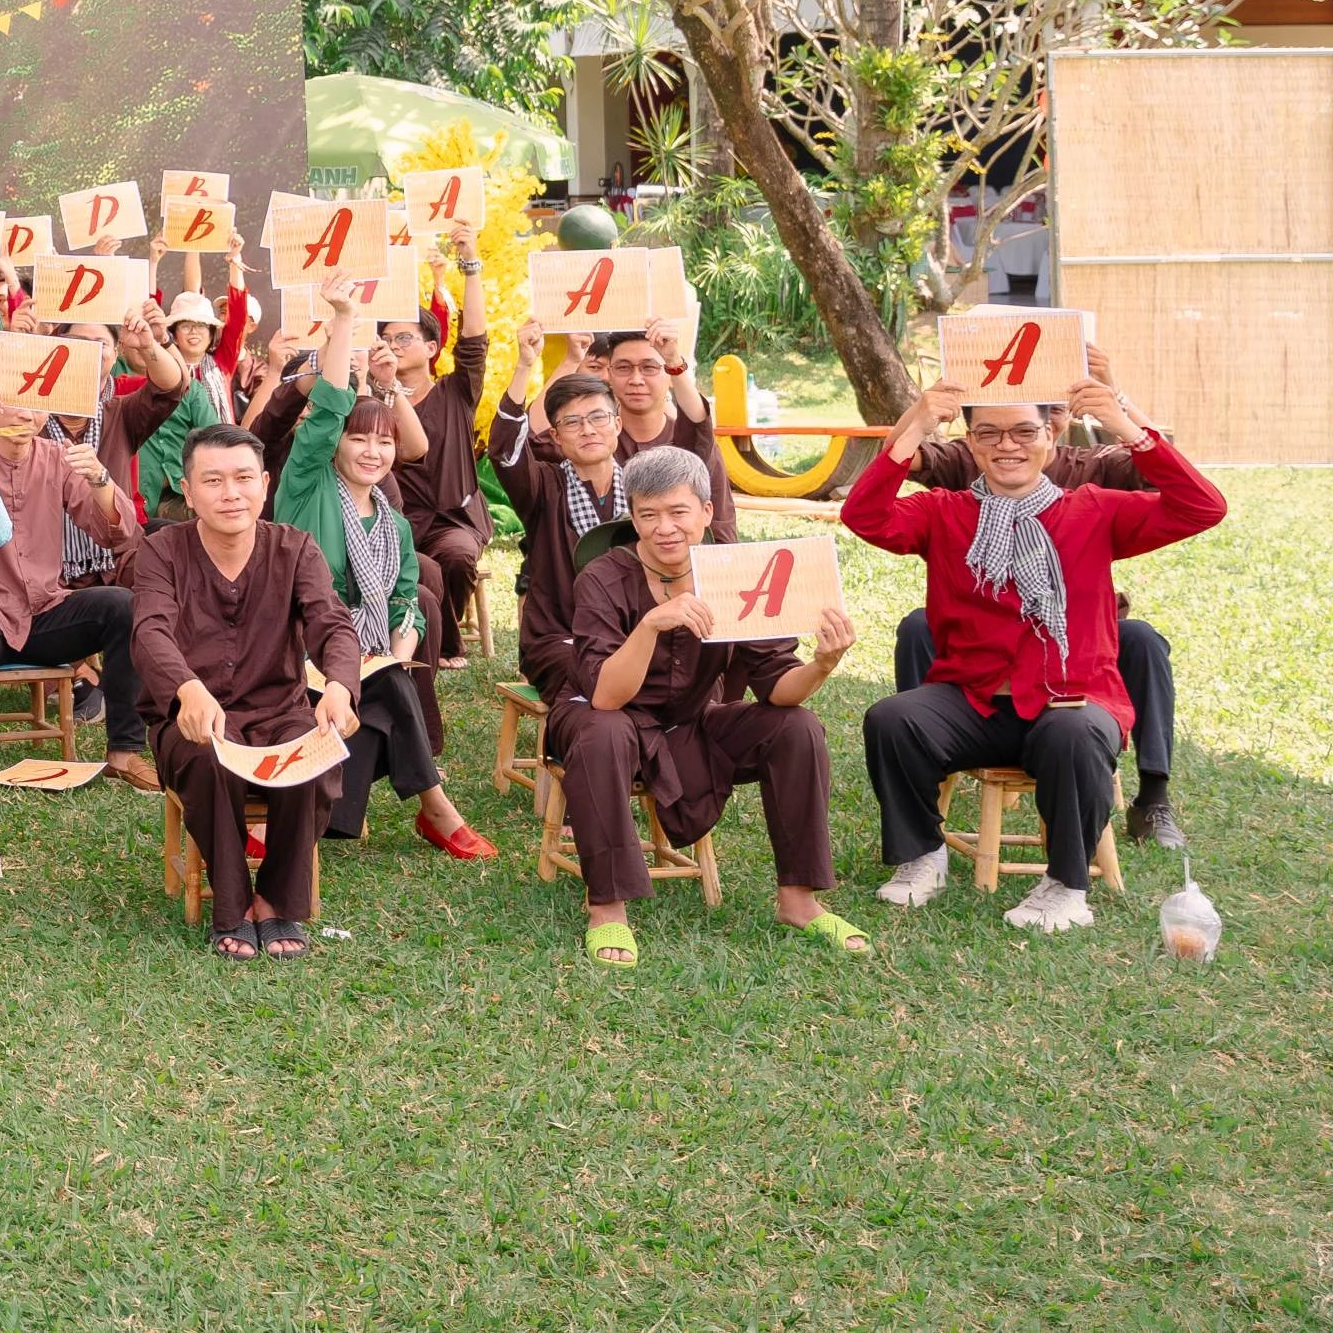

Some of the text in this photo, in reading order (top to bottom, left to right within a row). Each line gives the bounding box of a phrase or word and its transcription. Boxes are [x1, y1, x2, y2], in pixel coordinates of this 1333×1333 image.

[86, 194, 119, 236] D
[428, 176, 461, 222] A
[6, 224, 34, 257] D
[183, 208, 215, 243] B
[302, 207, 354, 269] A
[58, 264, 105, 313] D
[564, 257, 614, 316] A
[16, 344, 70, 398] A
[980, 321, 1043, 389] A
[738, 548, 795, 619] A
